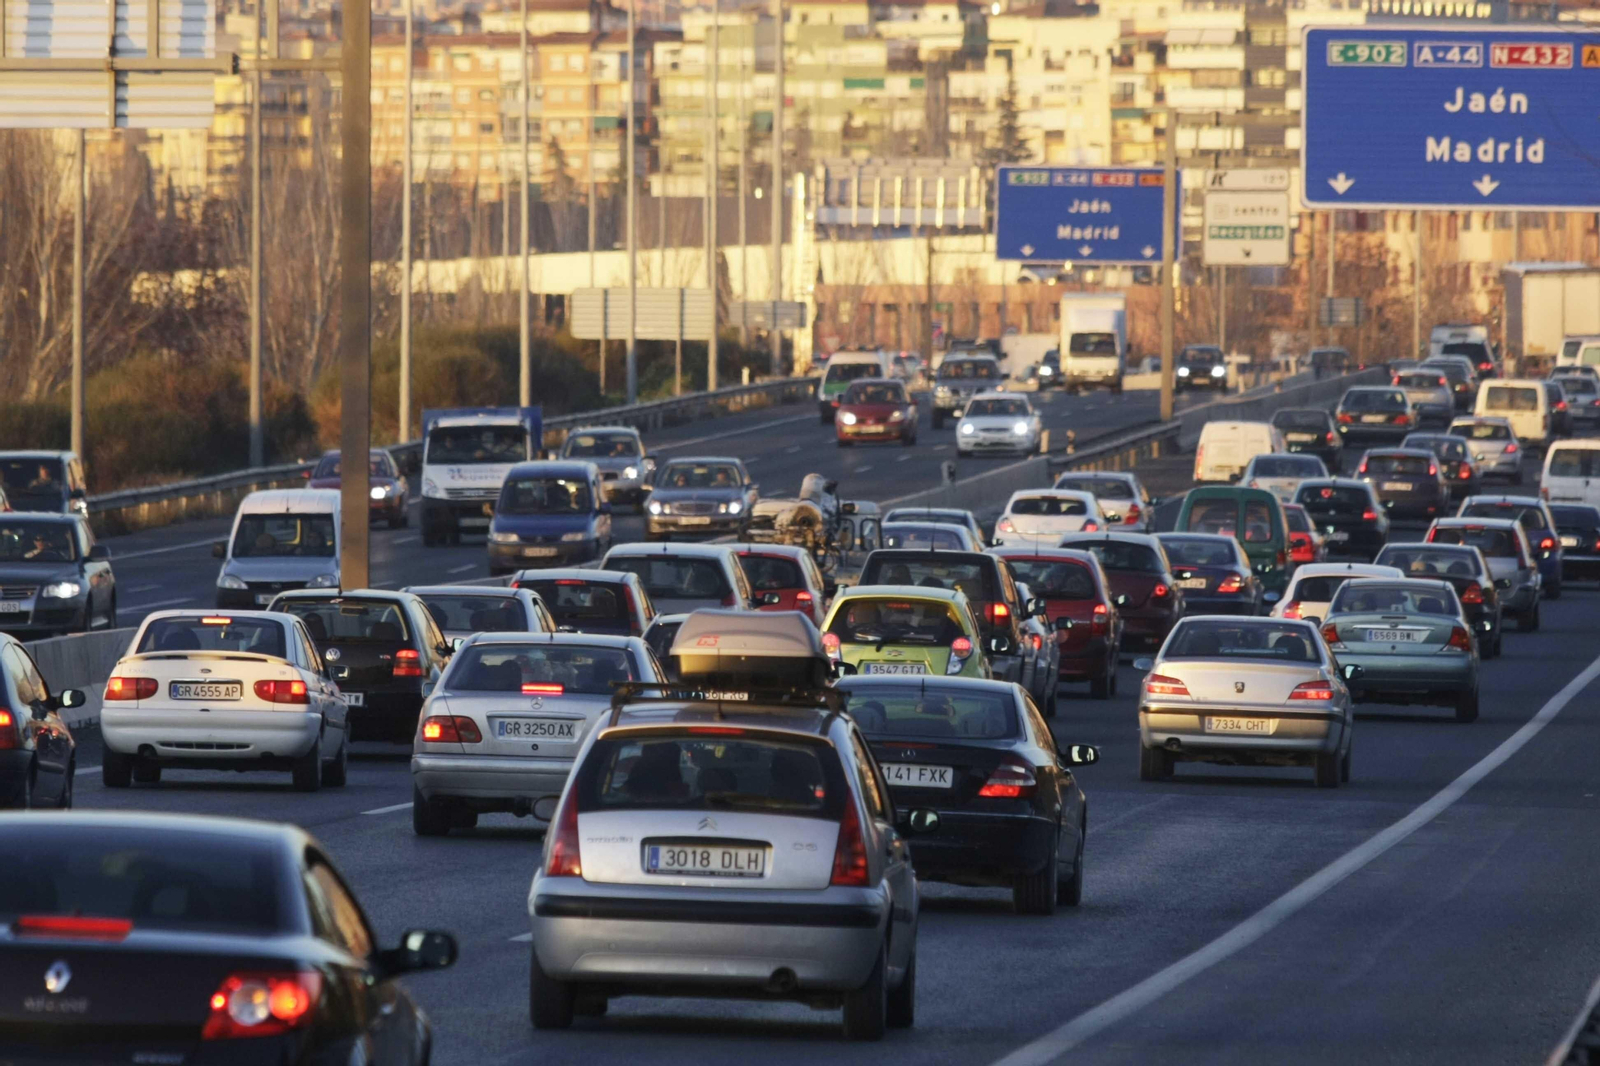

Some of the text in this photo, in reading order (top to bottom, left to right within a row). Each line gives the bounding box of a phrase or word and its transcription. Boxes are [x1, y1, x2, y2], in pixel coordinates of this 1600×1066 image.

[1331, 44, 1405, 63] E-902
[1418, 46, 1479, 64] A-44
[1494, 47, 1571, 66] N-432
[1444, 86, 1528, 114] Jaén
[1426, 136, 1545, 164] Madrid
[1067, 198, 1112, 214] Jaén
[1057, 223, 1120, 240] Madrid
[1373, 632, 1398, 640] 6569
[872, 665, 922, 674] 3547 GTX
[178, 684, 239, 698] GR 4555 AP
[505, 722, 573, 737] GR 3250 AX
[1215, 719, 1265, 731] 7334 CHT
[919, 768, 948, 783] FXK
[665, 849, 759, 870] 3018 DLH
